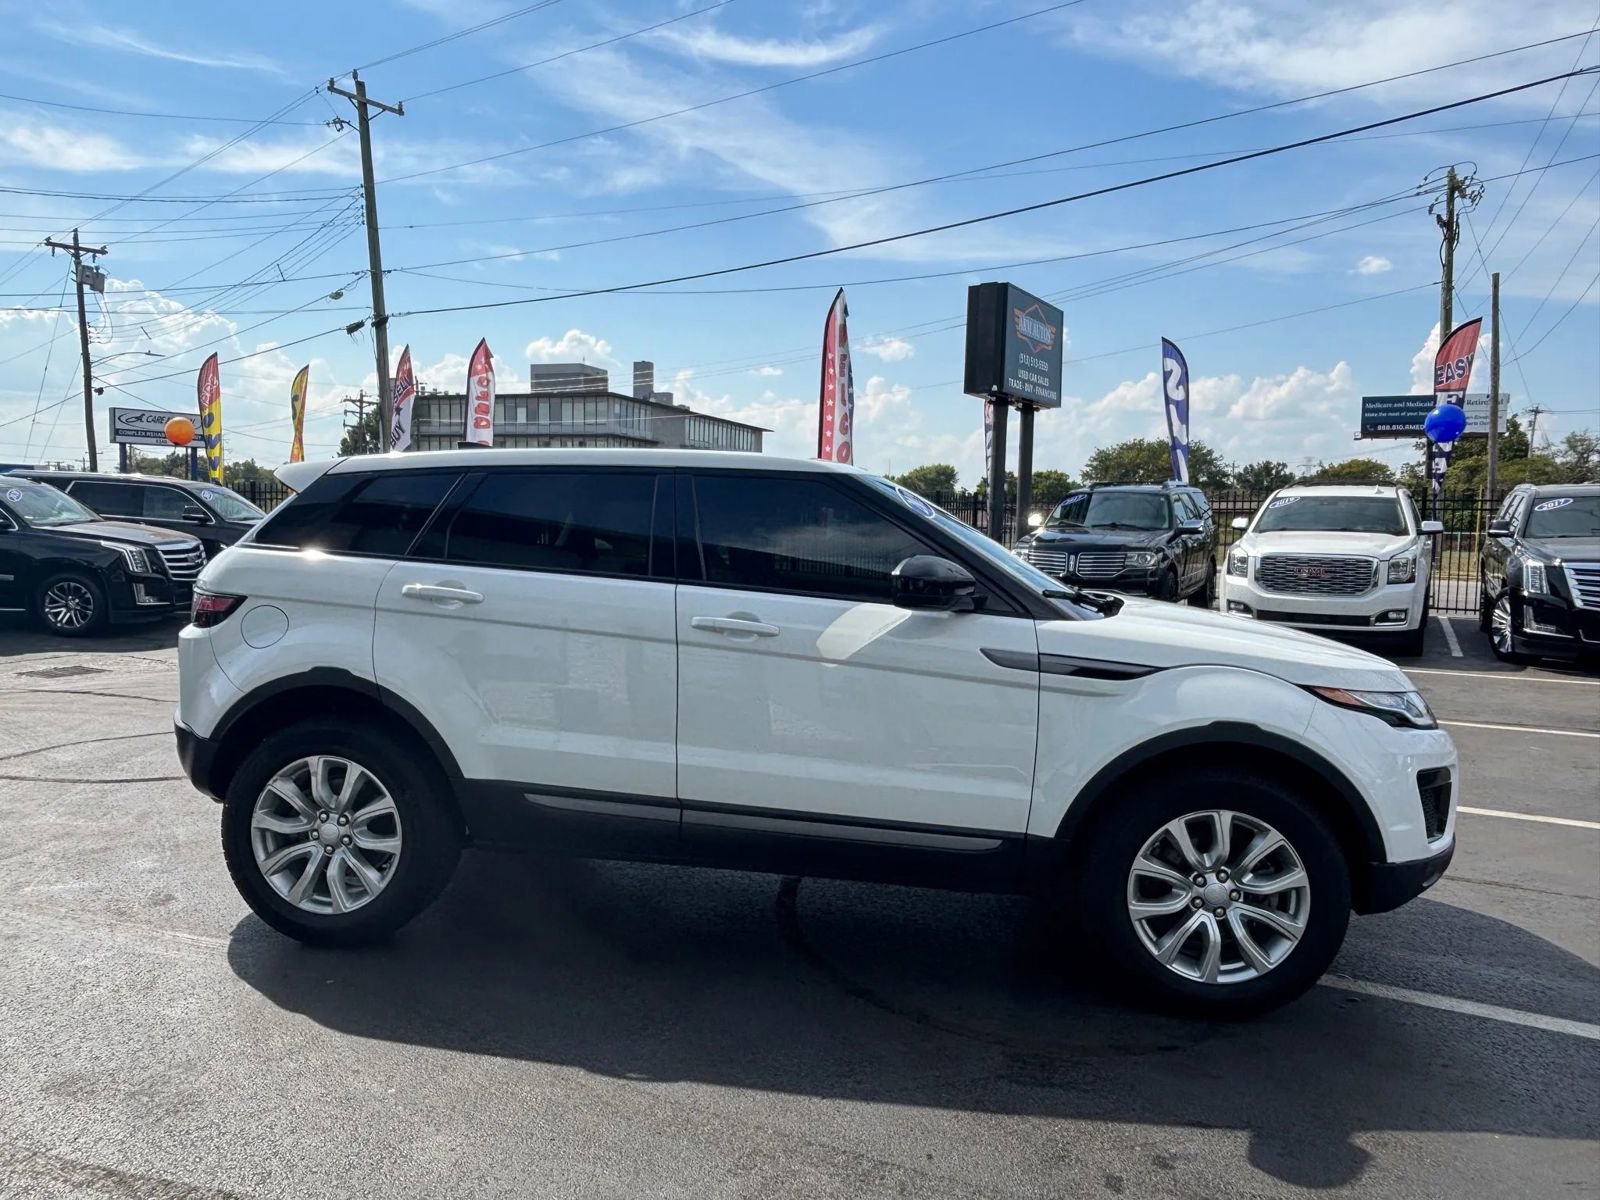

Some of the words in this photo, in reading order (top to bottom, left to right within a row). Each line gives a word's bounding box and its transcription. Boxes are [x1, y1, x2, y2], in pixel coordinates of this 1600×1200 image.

[1018, 368, 1029, 380] USED
[1029, 372, 1038, 383] CAR
[1038, 375, 1049, 387] SALES
[1435, 352, 1474, 386] EASY
[1009, 377, 1023, 390] TRADE
[1024, 382, 1033, 393] BUY
[1036, 385, 1057, 400] FINANCING
[146, 415, 166, 424] CARE
[1543, 498, 1566, 510] 2017
